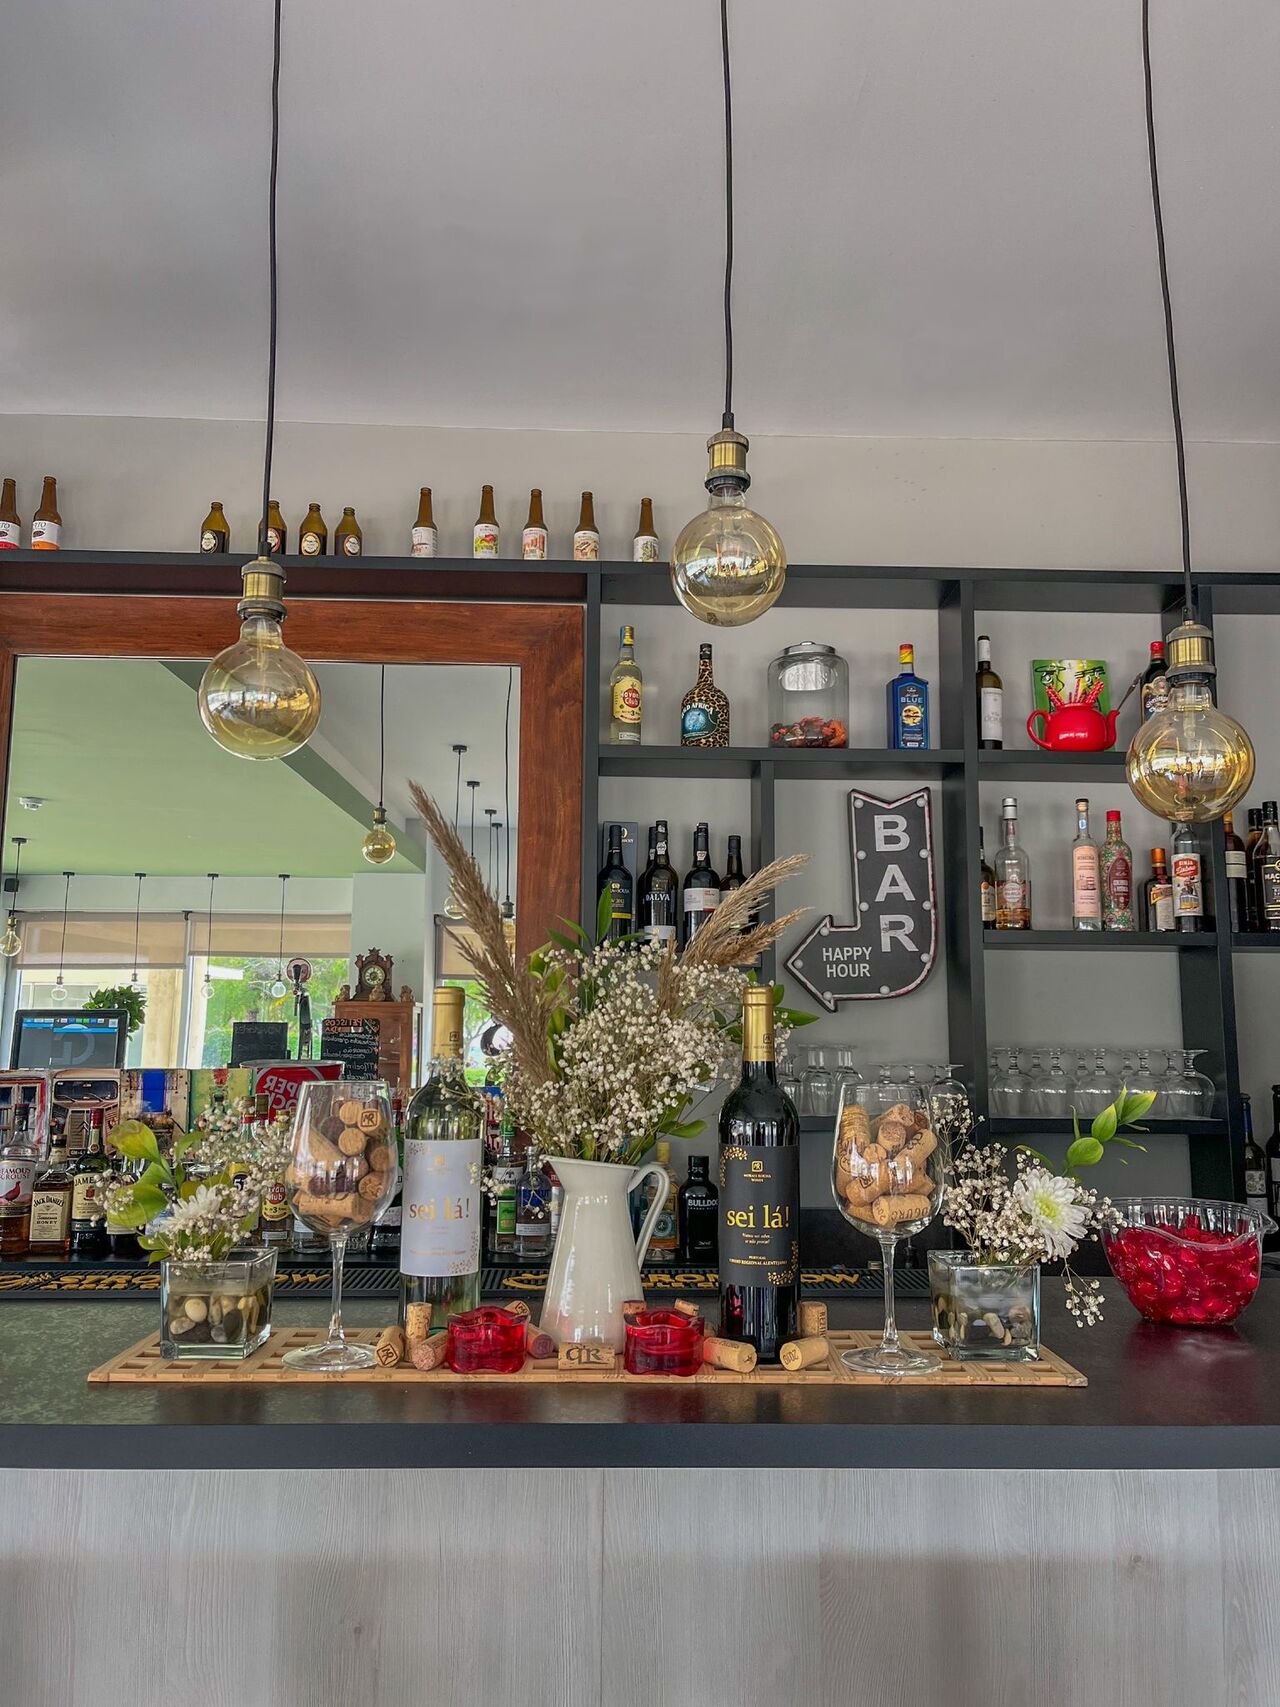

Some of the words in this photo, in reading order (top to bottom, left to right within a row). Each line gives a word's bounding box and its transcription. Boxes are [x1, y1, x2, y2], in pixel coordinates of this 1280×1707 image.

[873, 814, 919, 953] BAR
[645, 892, 671, 901] DALVA
[822, 947, 872, 962] HAPPY
[826, 963, 871, 978] HOUR
[409, 1197, 436, 1219] sei
[444, 1197, 470, 1219] lá!
[726, 1204, 756, 1229] sei
[762, 1204, 790, 1229] lá!
